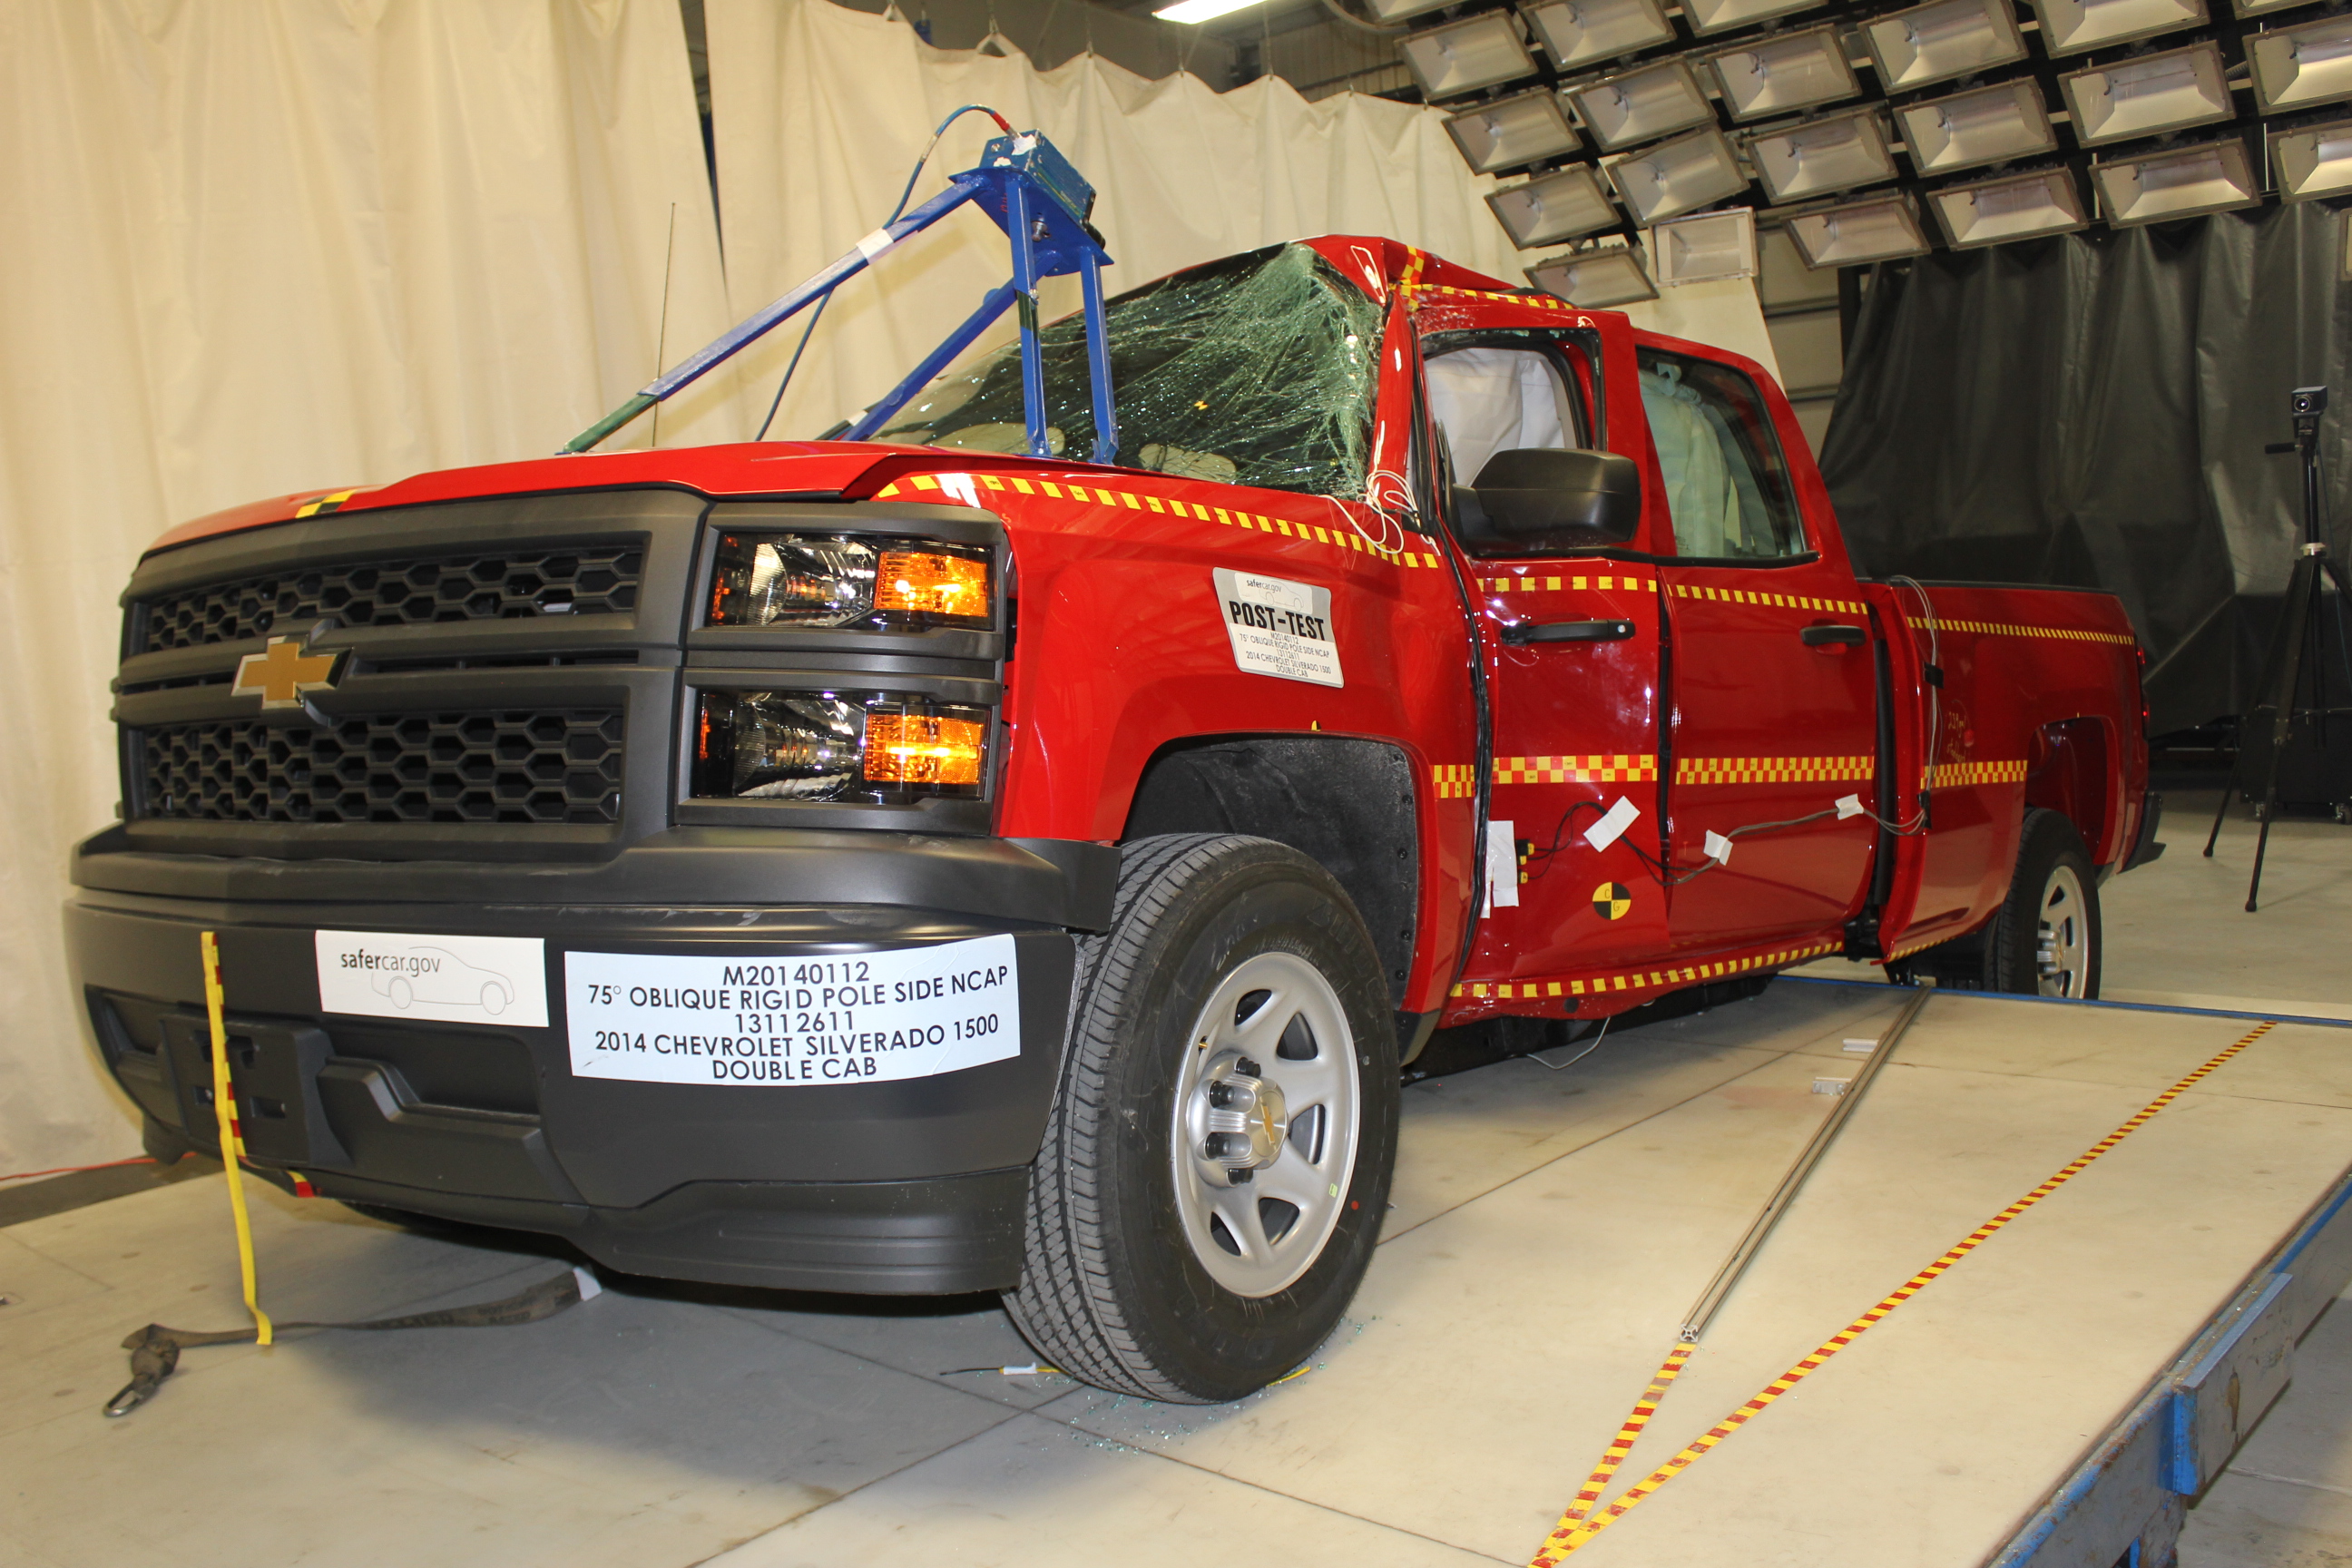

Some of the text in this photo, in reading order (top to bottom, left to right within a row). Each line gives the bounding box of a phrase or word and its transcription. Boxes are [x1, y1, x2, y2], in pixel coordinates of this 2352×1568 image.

[1247, 579, 1282, 593] safercar.gov
[1229, 601, 1326, 642] POST-TEST
[1250, 635, 1275, 647] OBLIQUE
[1274, 641, 1289, 652] RIGID
[1289, 643, 1303, 653] POLE
[1303, 645, 1314, 656] SIDE
[1315, 647, 1329, 658] NCAP
[1270, 632, 1299, 644] M20140112
[1245, 650, 1331, 674] 2014 CHEVROLET SILVERADO 1500
[1277, 649, 1300, 661] 13112611
[1276, 664, 1308, 678] DOUBLE CAB
[1604, 888, 1611, 898] C
[1612, 901, 1621, 911] G
[340, 948, 441, 977] safercar.gov
[723, 961, 870, 986] M20140112
[588, 965, 1009, 1011] 75° OBLIQUE RIGID POLE SIDE NCAP
[734, 1010, 854, 1034] 13112611
[594, 1013, 999, 1058] 2014 CHEVROLET SILVERADO 1500
[712, 1056, 877, 1081] DOUBLE CAB
